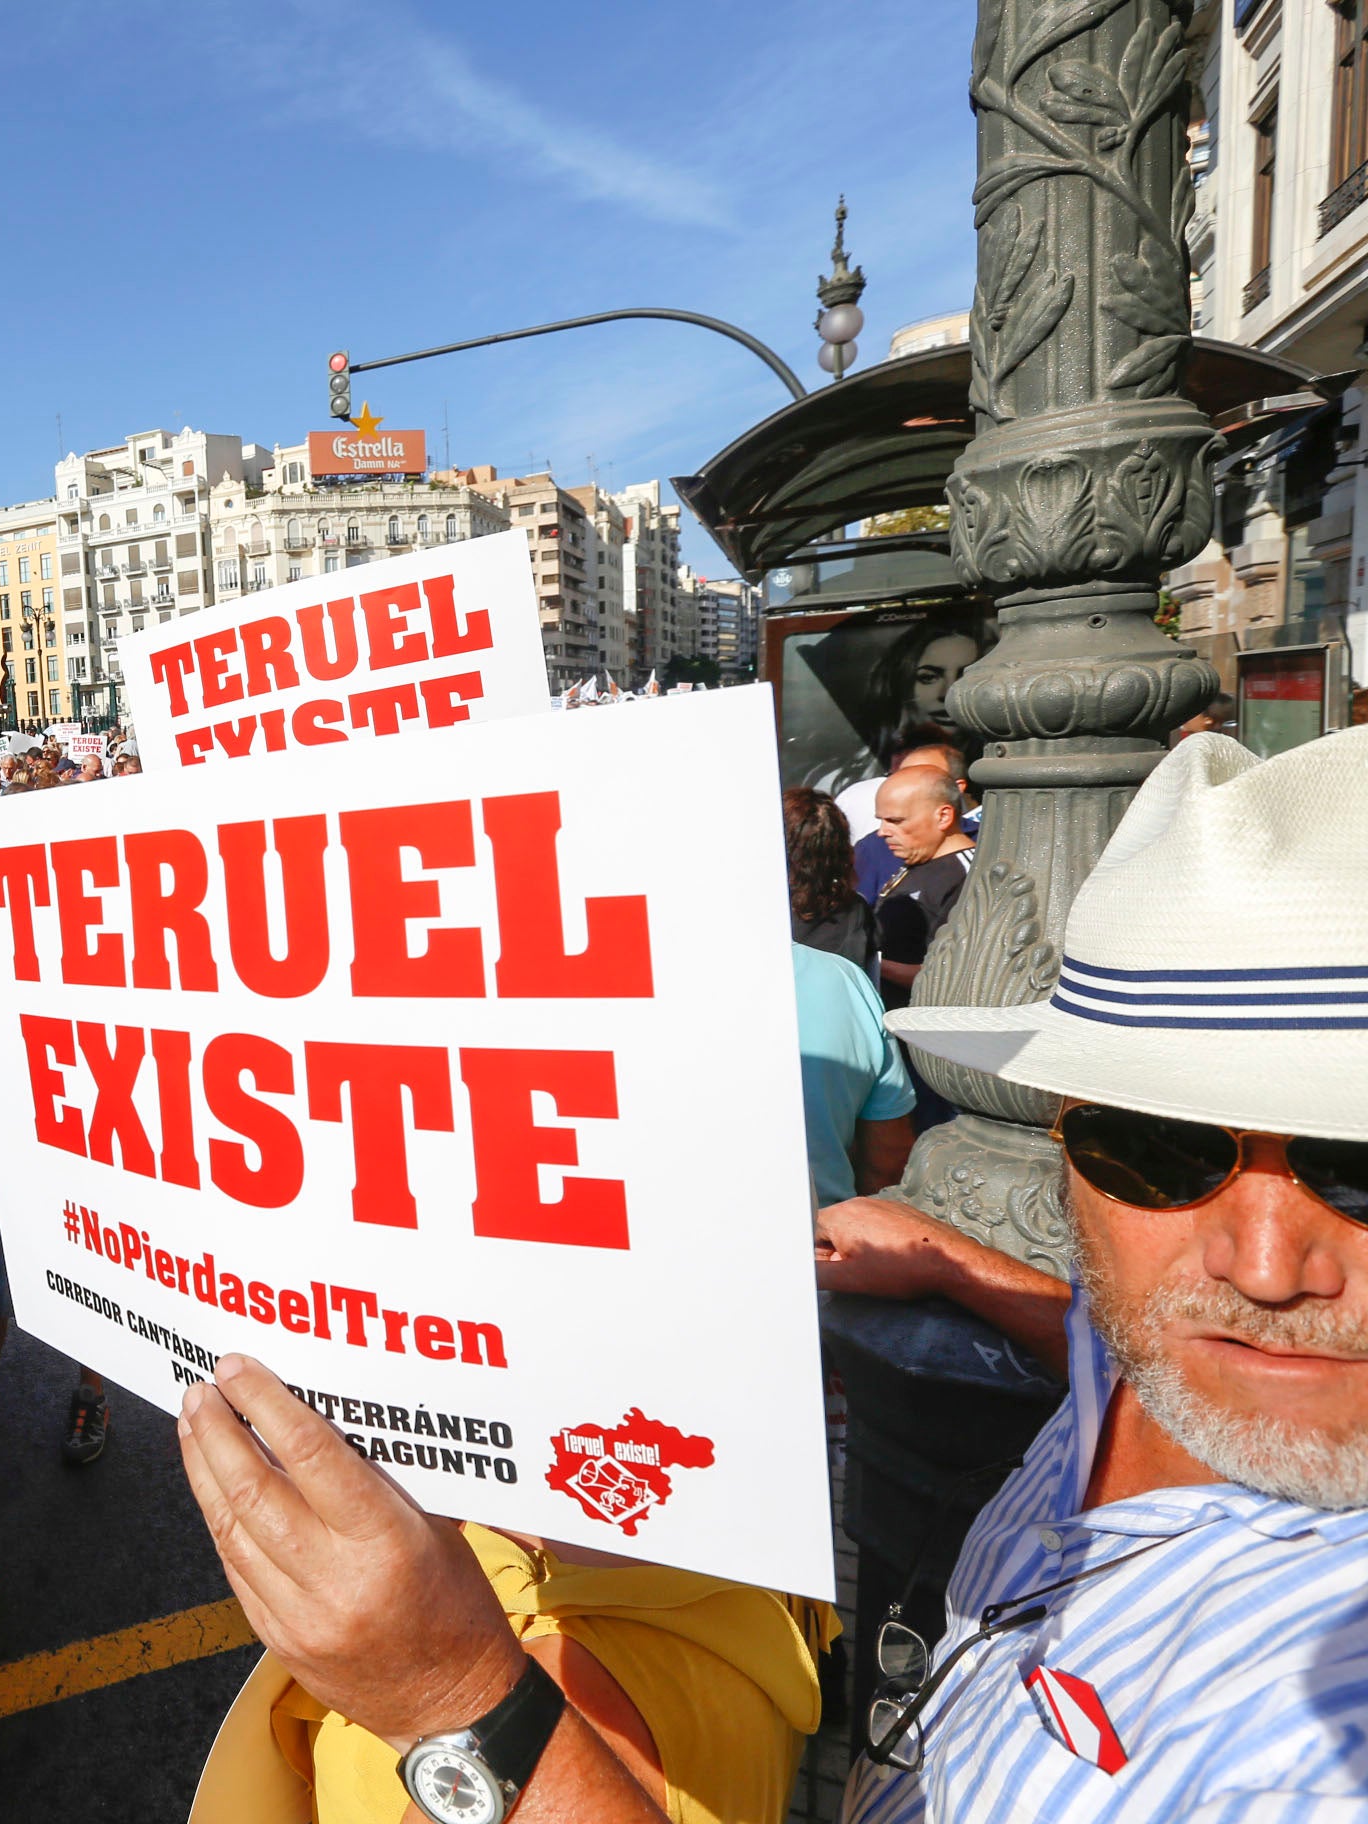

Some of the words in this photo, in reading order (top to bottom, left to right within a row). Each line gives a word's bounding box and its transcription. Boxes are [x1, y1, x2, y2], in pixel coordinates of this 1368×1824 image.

[332, 435, 405, 458] Estrella
[353, 458, 385, 470] Damm
[150, 575, 493, 718] TERUEL
[72, 737, 103, 745] TERUEL
[72, 745, 101, 753] EXISTE
[20, 1014, 630, 1251] EXISTE
[62, 1199, 508, 1369] #NoPierdaselTren
[46, 1268, 124, 1326] CORREDOR
[126, 1309, 221, 1375] CANTÁBRI
[344, 1433, 519, 1485] SAGUNTO
[561, 1429, 605, 1457] Teruel
[613, 1440, 661, 1467] existe!
